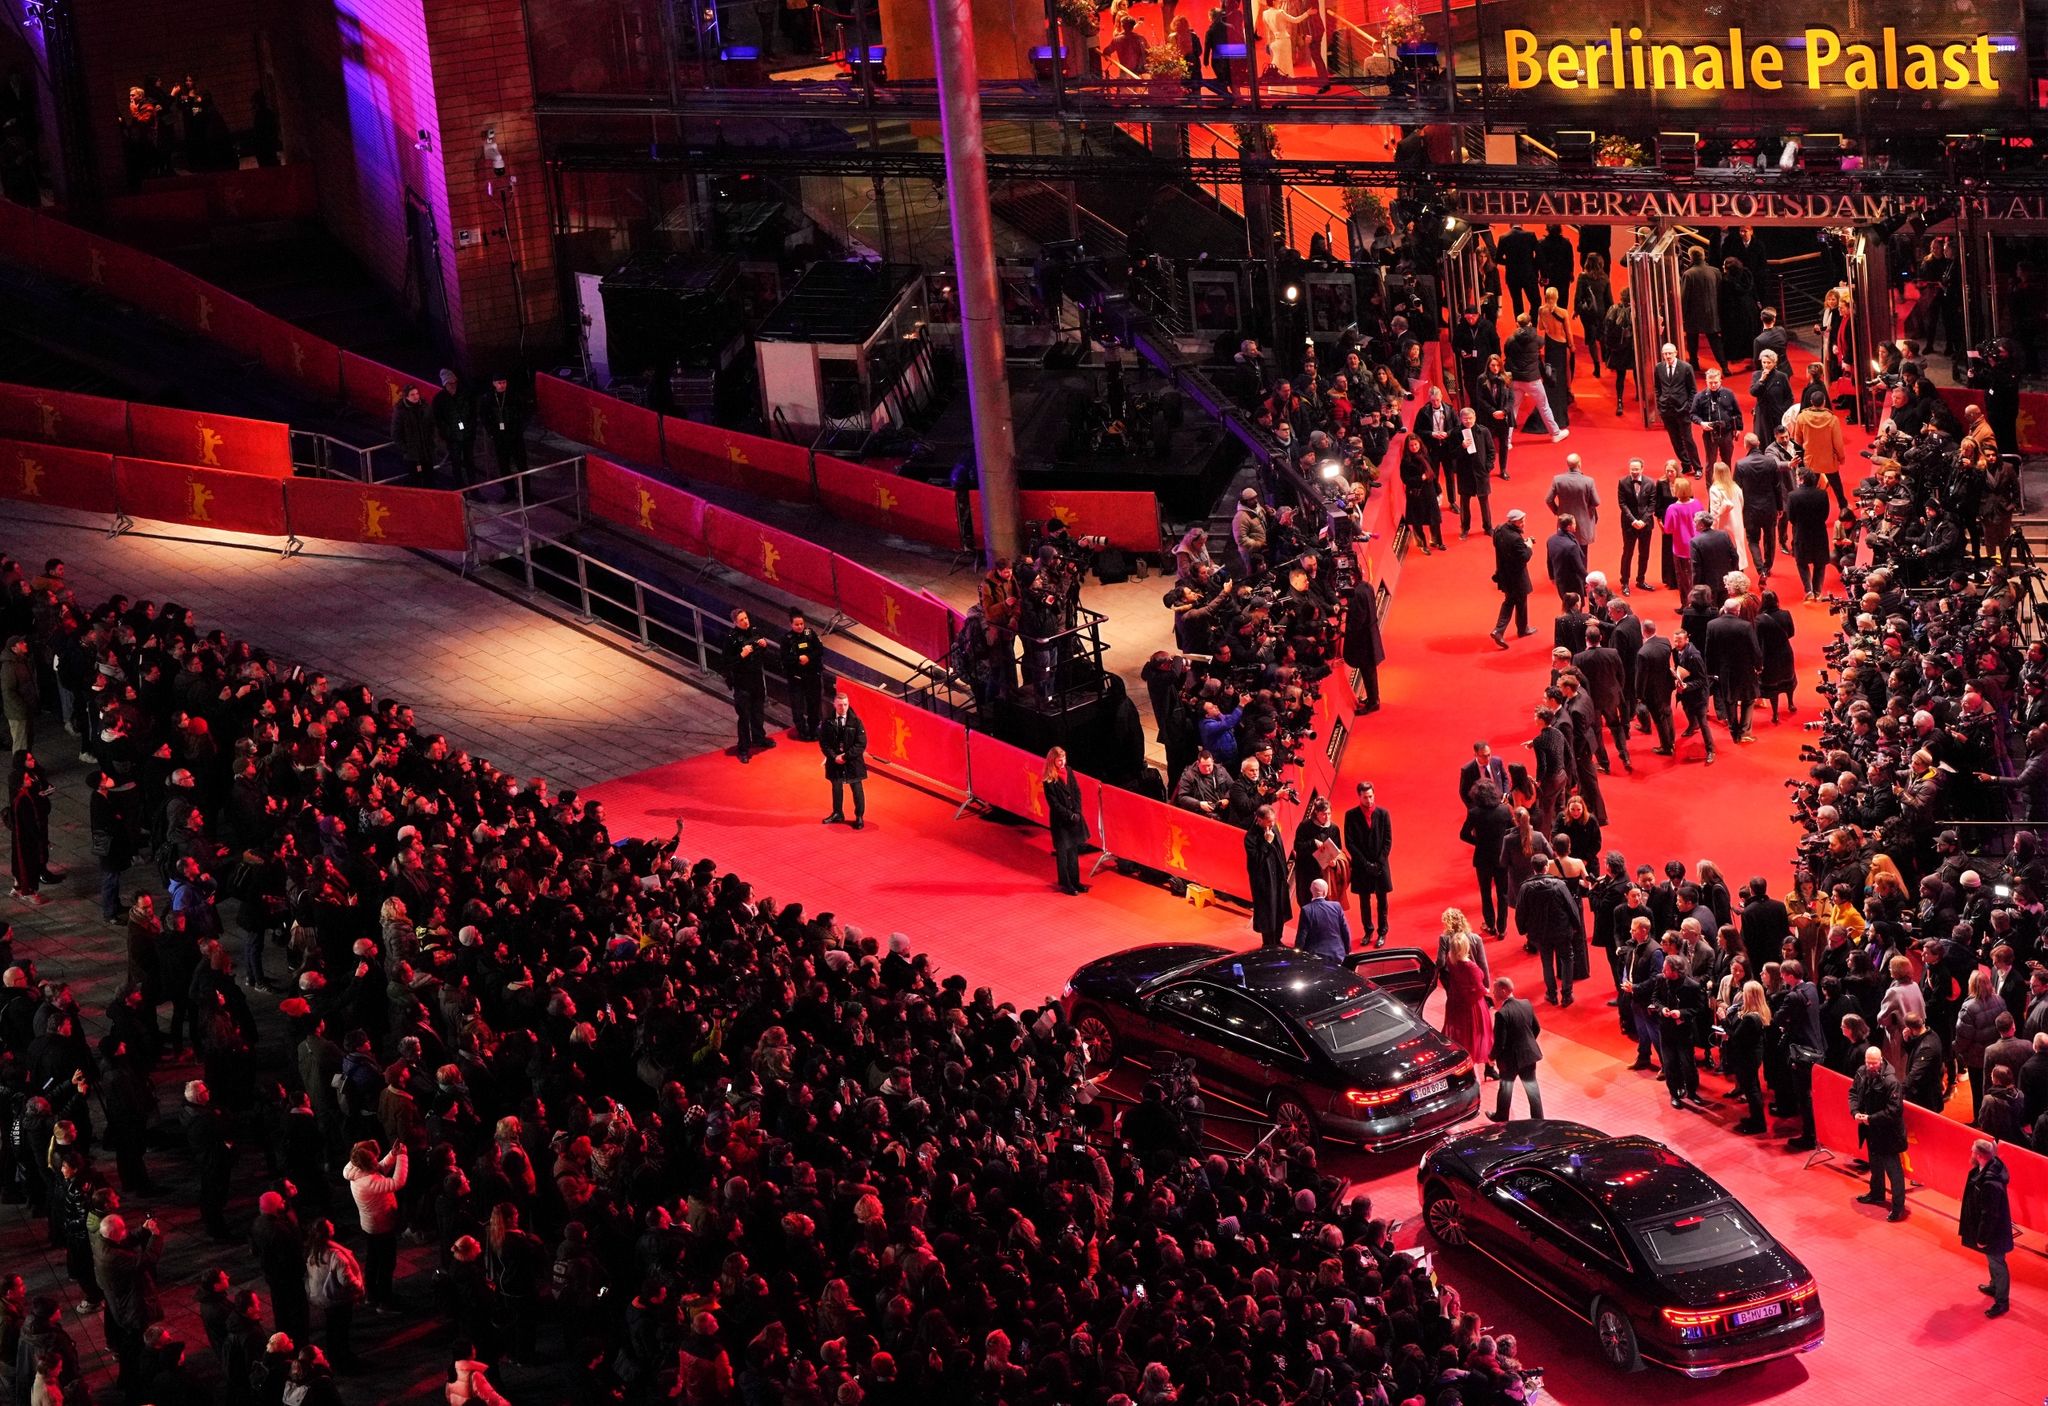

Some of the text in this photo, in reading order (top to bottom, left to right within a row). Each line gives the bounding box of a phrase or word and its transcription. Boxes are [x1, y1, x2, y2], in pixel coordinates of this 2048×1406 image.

[1504, 27, 2000, 91] Berlinale Palast
[1458, 190, 1629, 217] THEATER
[1637, 191, 1700, 218] AM
[1751, 1309, 1761, 1319] MV
[1763, 1304, 1778, 1317] 167
